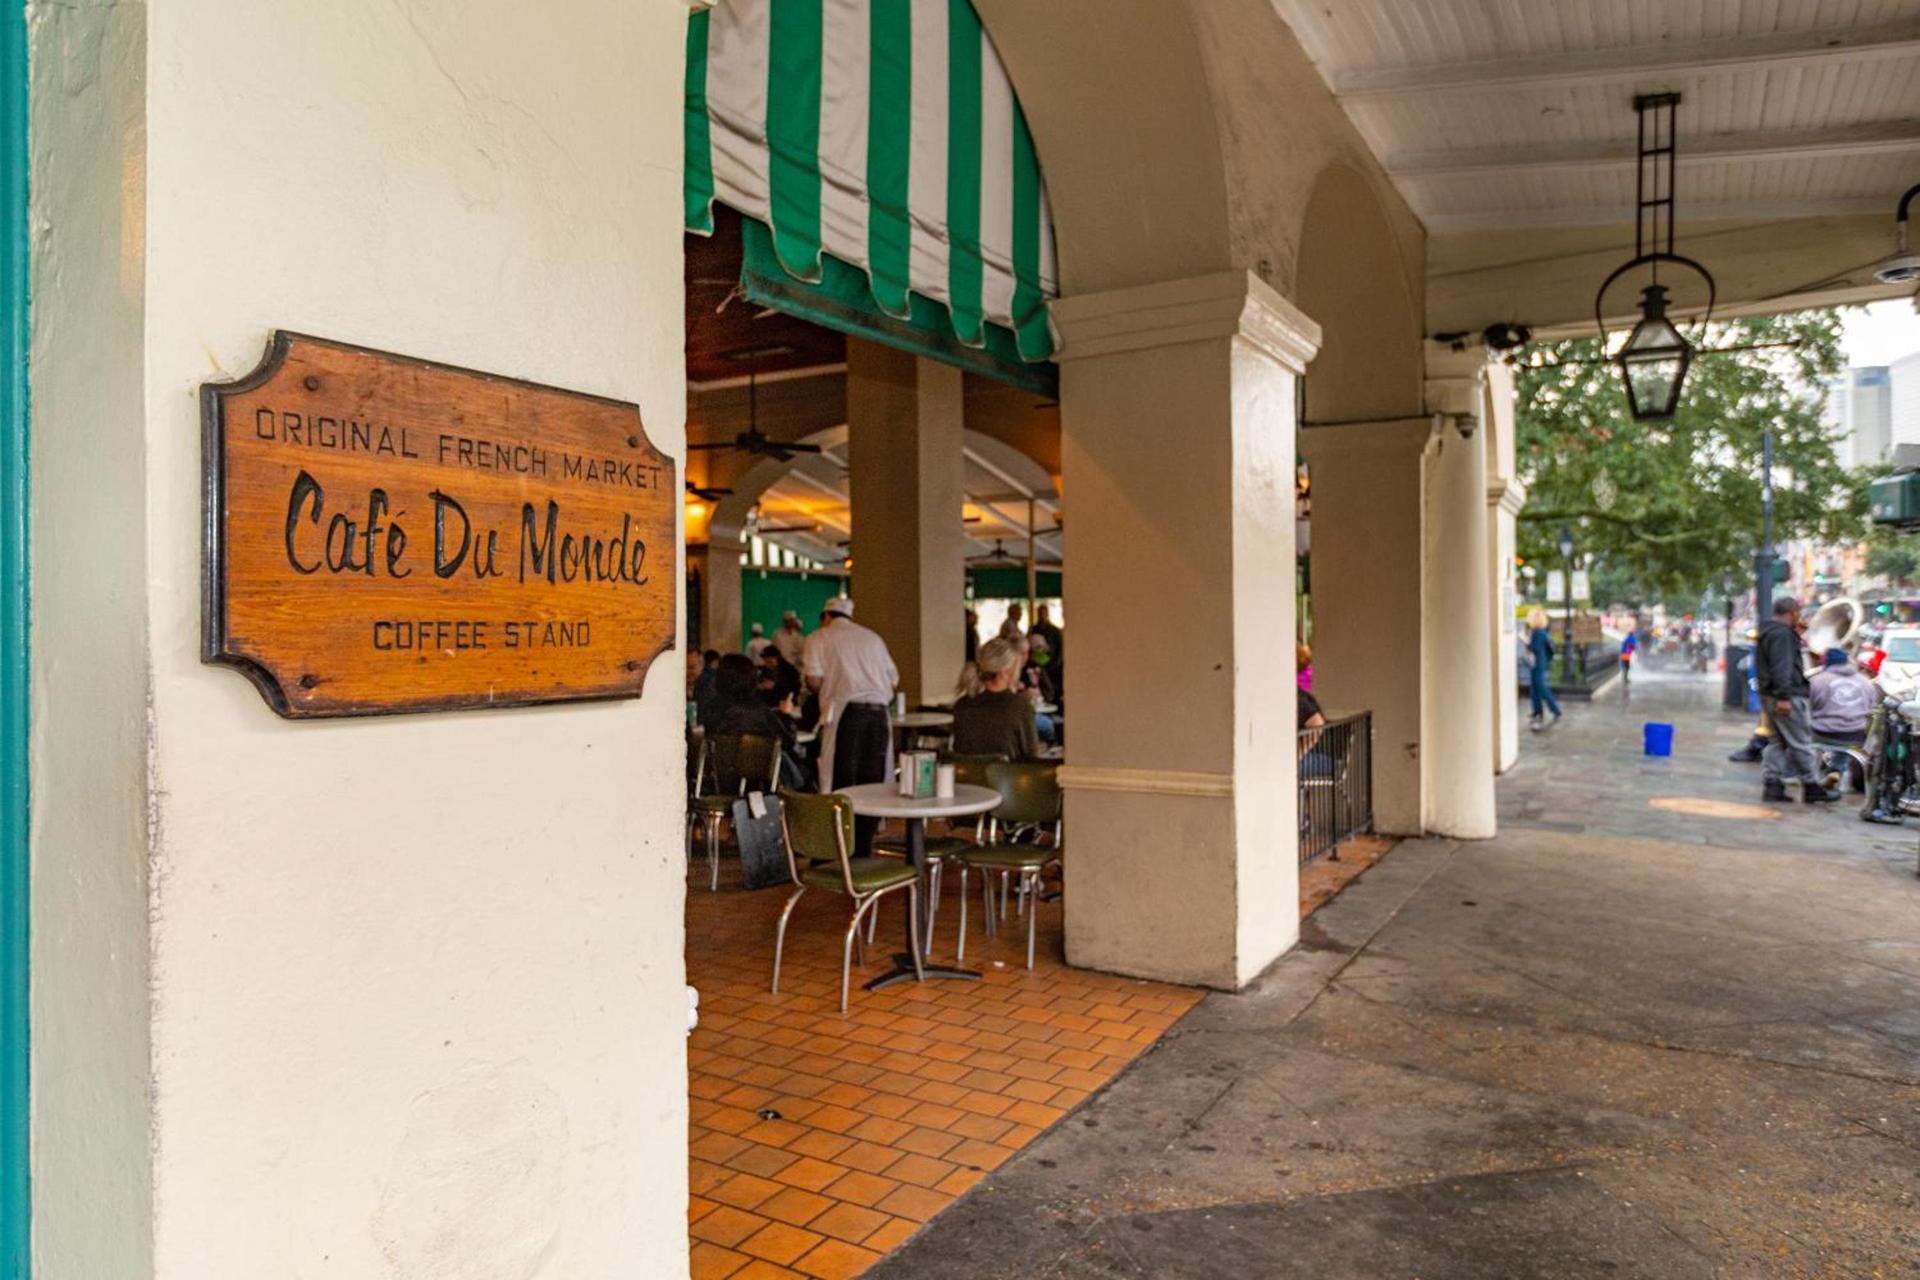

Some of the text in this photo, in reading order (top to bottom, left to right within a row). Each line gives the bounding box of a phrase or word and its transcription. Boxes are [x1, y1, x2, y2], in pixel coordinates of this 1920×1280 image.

[256, 408, 662, 489] ORIGINAL FRENCH MARKET
[285, 469, 649, 586] Café Du Monde
[373, 620, 590, 651] COFFEE STAND
